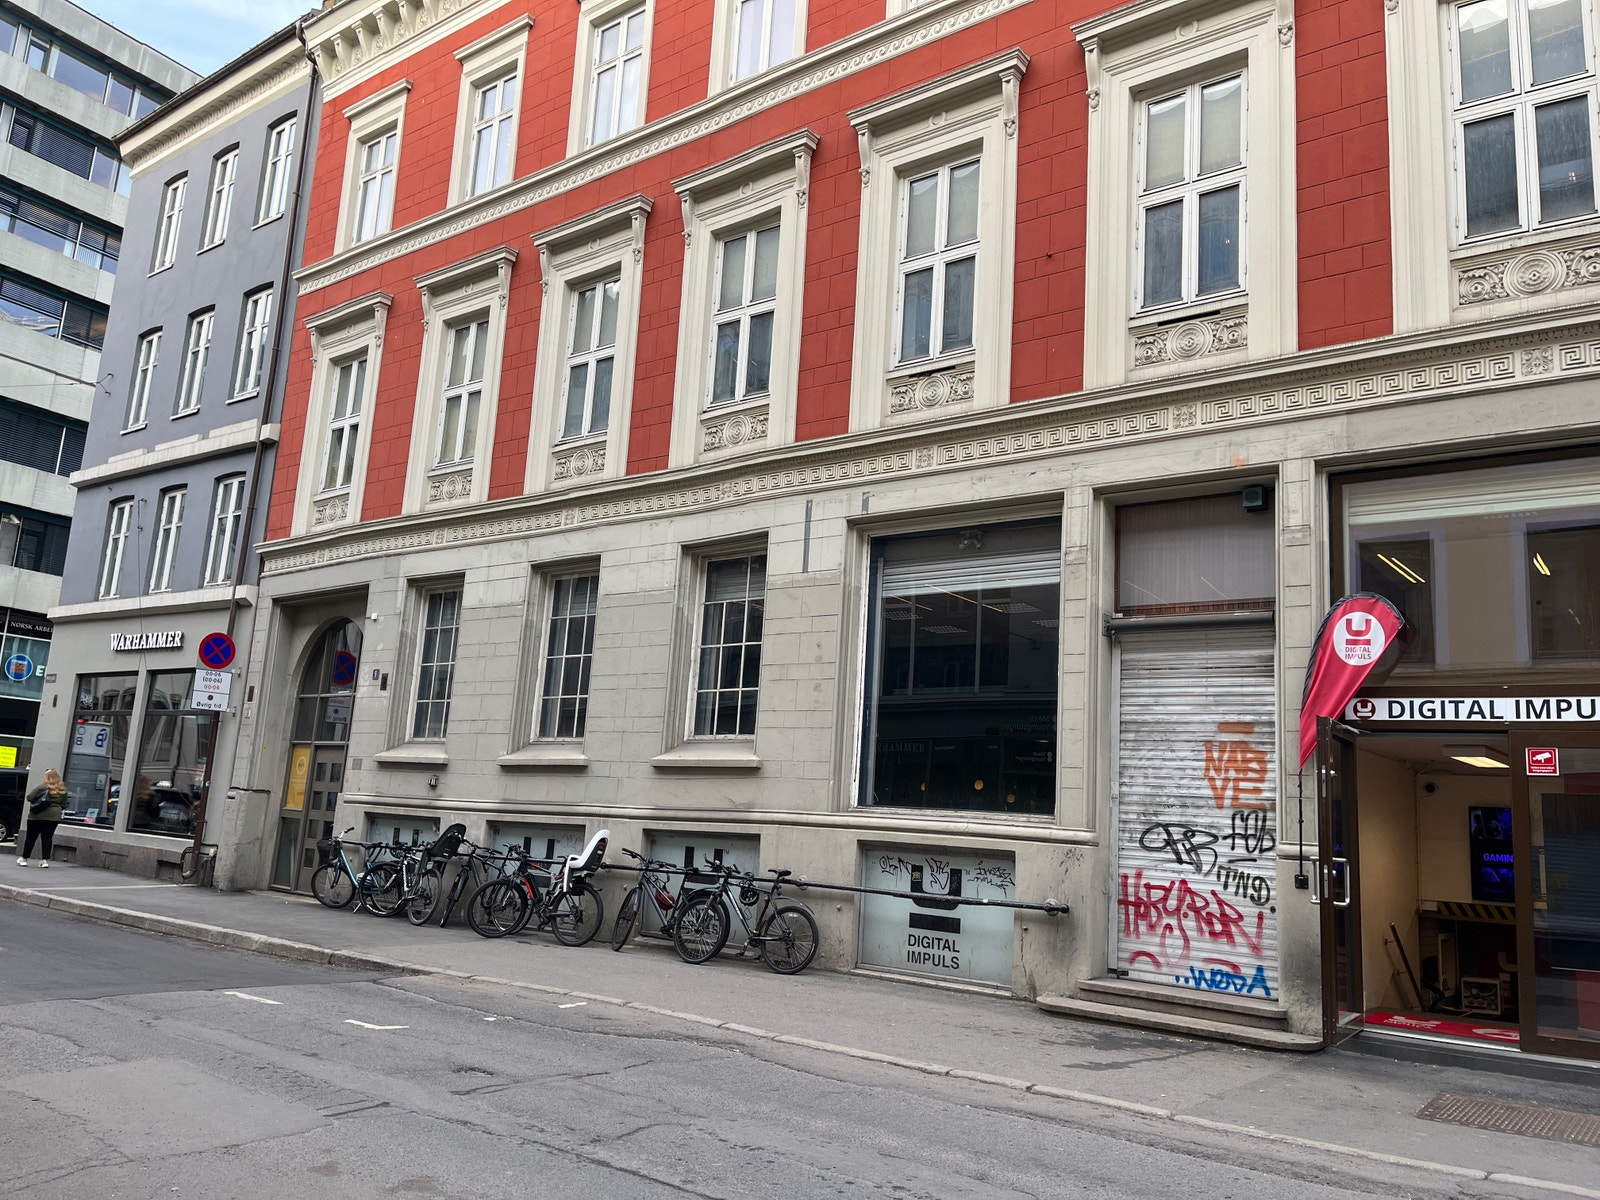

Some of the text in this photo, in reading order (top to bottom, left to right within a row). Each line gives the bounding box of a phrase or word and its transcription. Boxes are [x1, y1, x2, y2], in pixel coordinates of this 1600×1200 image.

[10, 621, 33, 630] NORSK
[110, 630, 182, 651] WARHAMMER
[202, 676, 223, 684] (00-06)
[196, 701, 212, 709] Øvrig
[1387, 699, 1504, 720] DIGITAL
[1515, 698, 1597, 720] IMPU
[1483, 853, 1514, 863] GAMIN
[908, 933, 960, 953] DIGITAL
[907, 950, 960, 970] IMPULS
